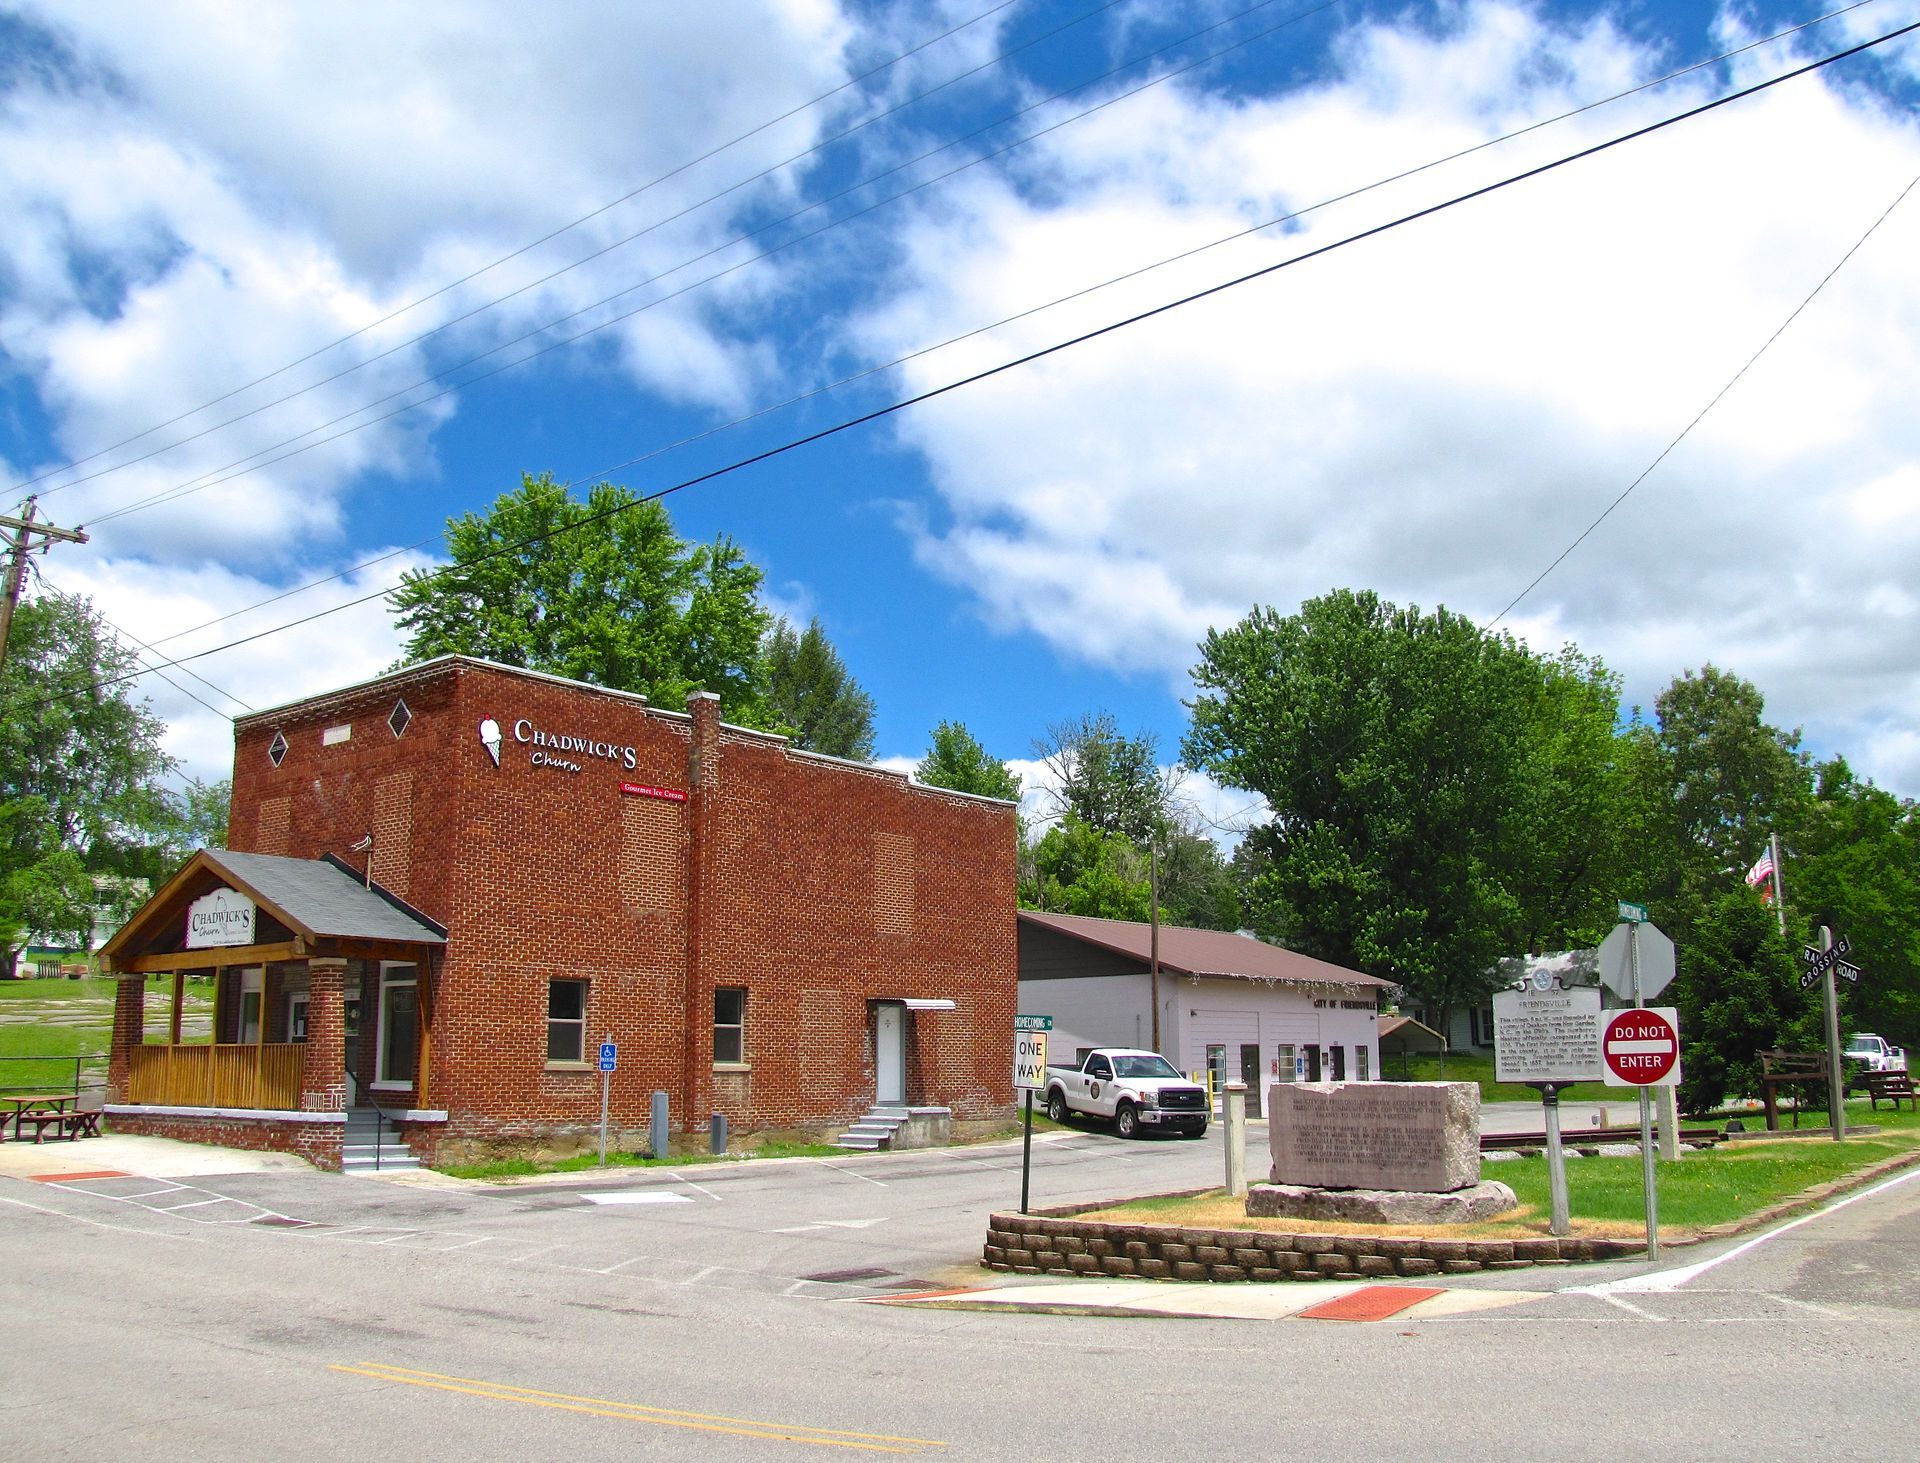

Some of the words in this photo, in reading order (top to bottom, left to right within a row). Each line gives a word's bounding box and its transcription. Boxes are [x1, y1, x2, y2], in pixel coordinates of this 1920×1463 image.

[514, 719, 637, 769] CHADWICK'S
[532, 752, 581, 772] Churn
[624, 783, 651, 794] Gourmet
[653, 788, 662, 796] Ice
[664, 790, 684, 800] Cream
[192, 909, 250, 932] CHADWICK'S
[1801, 941, 1846, 987] CROSSING
[1804, 950, 1820, 963] RAI
[1836, 964, 1857, 982] ROAD
[1014, 1016, 1046, 1028] HOMECOMING
[1615, 1027, 1634, 1039] DO
[1638, 1025, 1667, 1038] NOT
[1019, 1042, 1042, 1056] ONE
[1620, 1055, 1662, 1068] ENTER
[1017, 1064, 1042, 1078] WAY
